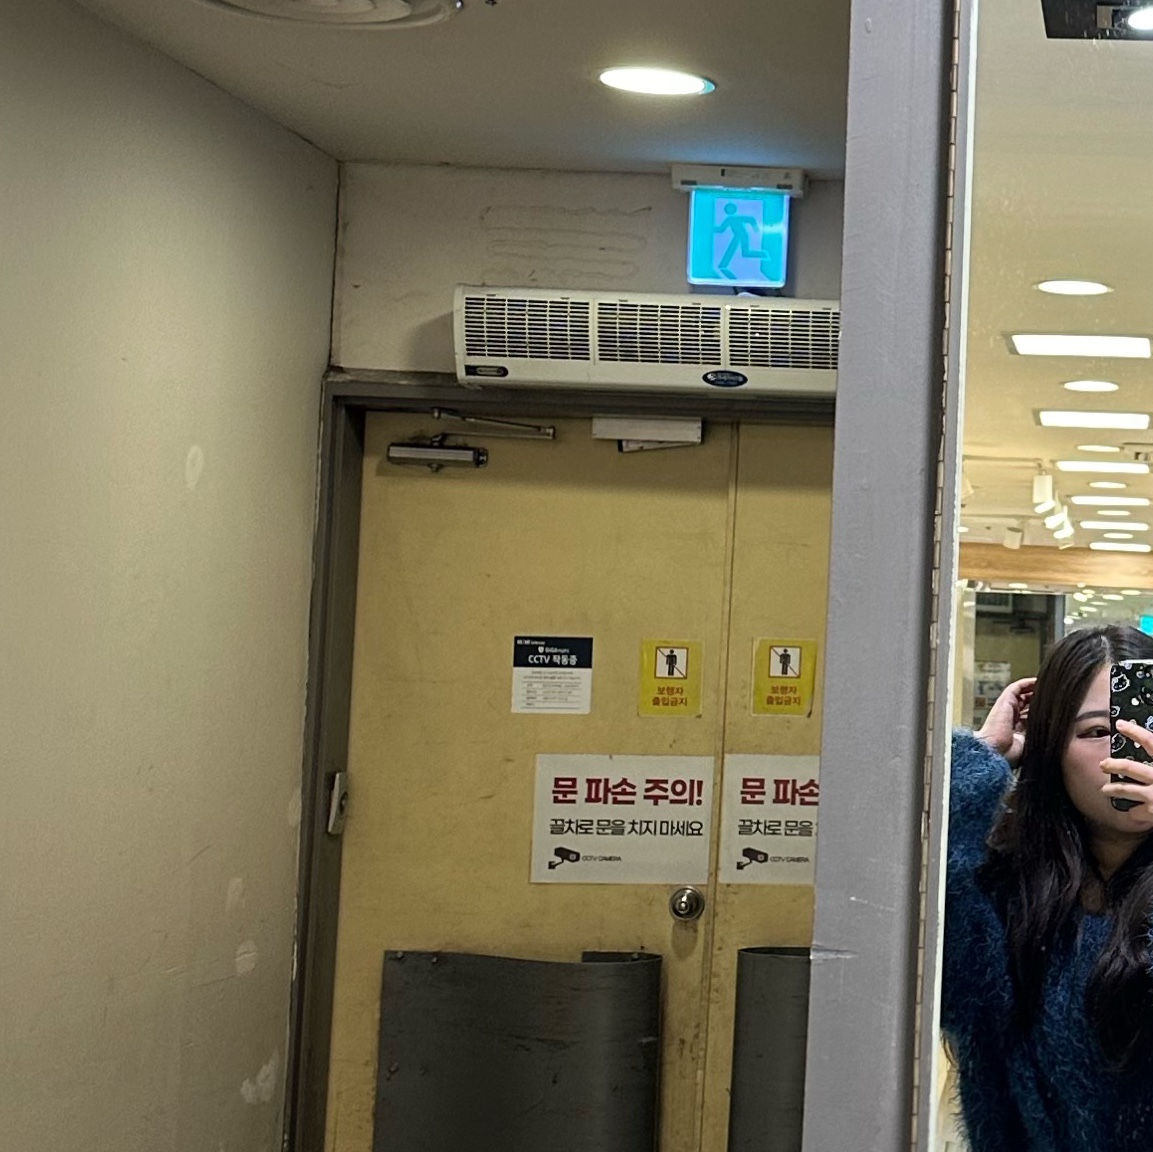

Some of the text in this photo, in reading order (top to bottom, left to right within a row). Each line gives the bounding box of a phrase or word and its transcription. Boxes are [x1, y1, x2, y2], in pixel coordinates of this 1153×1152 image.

[528, 655, 550, 664] CCTV
[657, 685, 684, 696] 보행자
[771, 685, 797, 695] 보행자
[652, 696, 688, 707] 출입금지
[766, 695, 801, 706] 출입금지
[552, 777, 704, 806] 문 파손 주의!
[740, 777, 819, 806] 문 파손
[549, 818, 704, 836] 끌차로 문을 치지 마세요
[738, 819, 813, 837] 끌차로 문을
